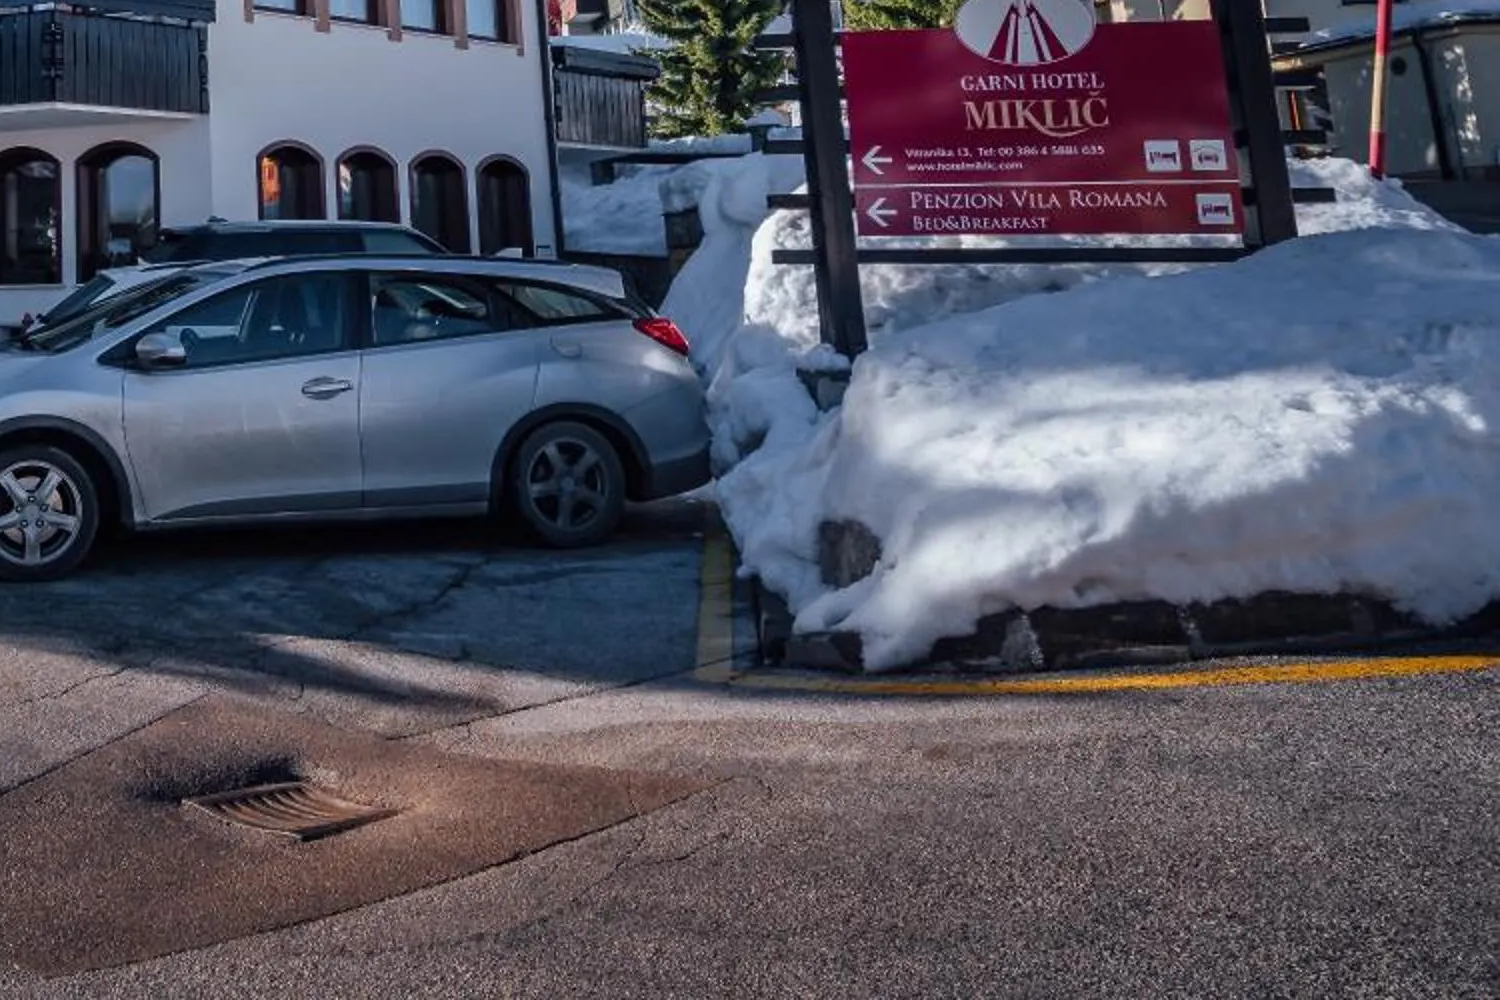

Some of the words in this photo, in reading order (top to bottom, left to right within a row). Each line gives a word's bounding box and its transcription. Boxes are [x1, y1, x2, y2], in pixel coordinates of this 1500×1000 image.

[960, 74, 1026, 91] GARNI
[1031, 72, 1105, 90] HOTEL
[963, 90, 1110, 138] MIKLIČ
